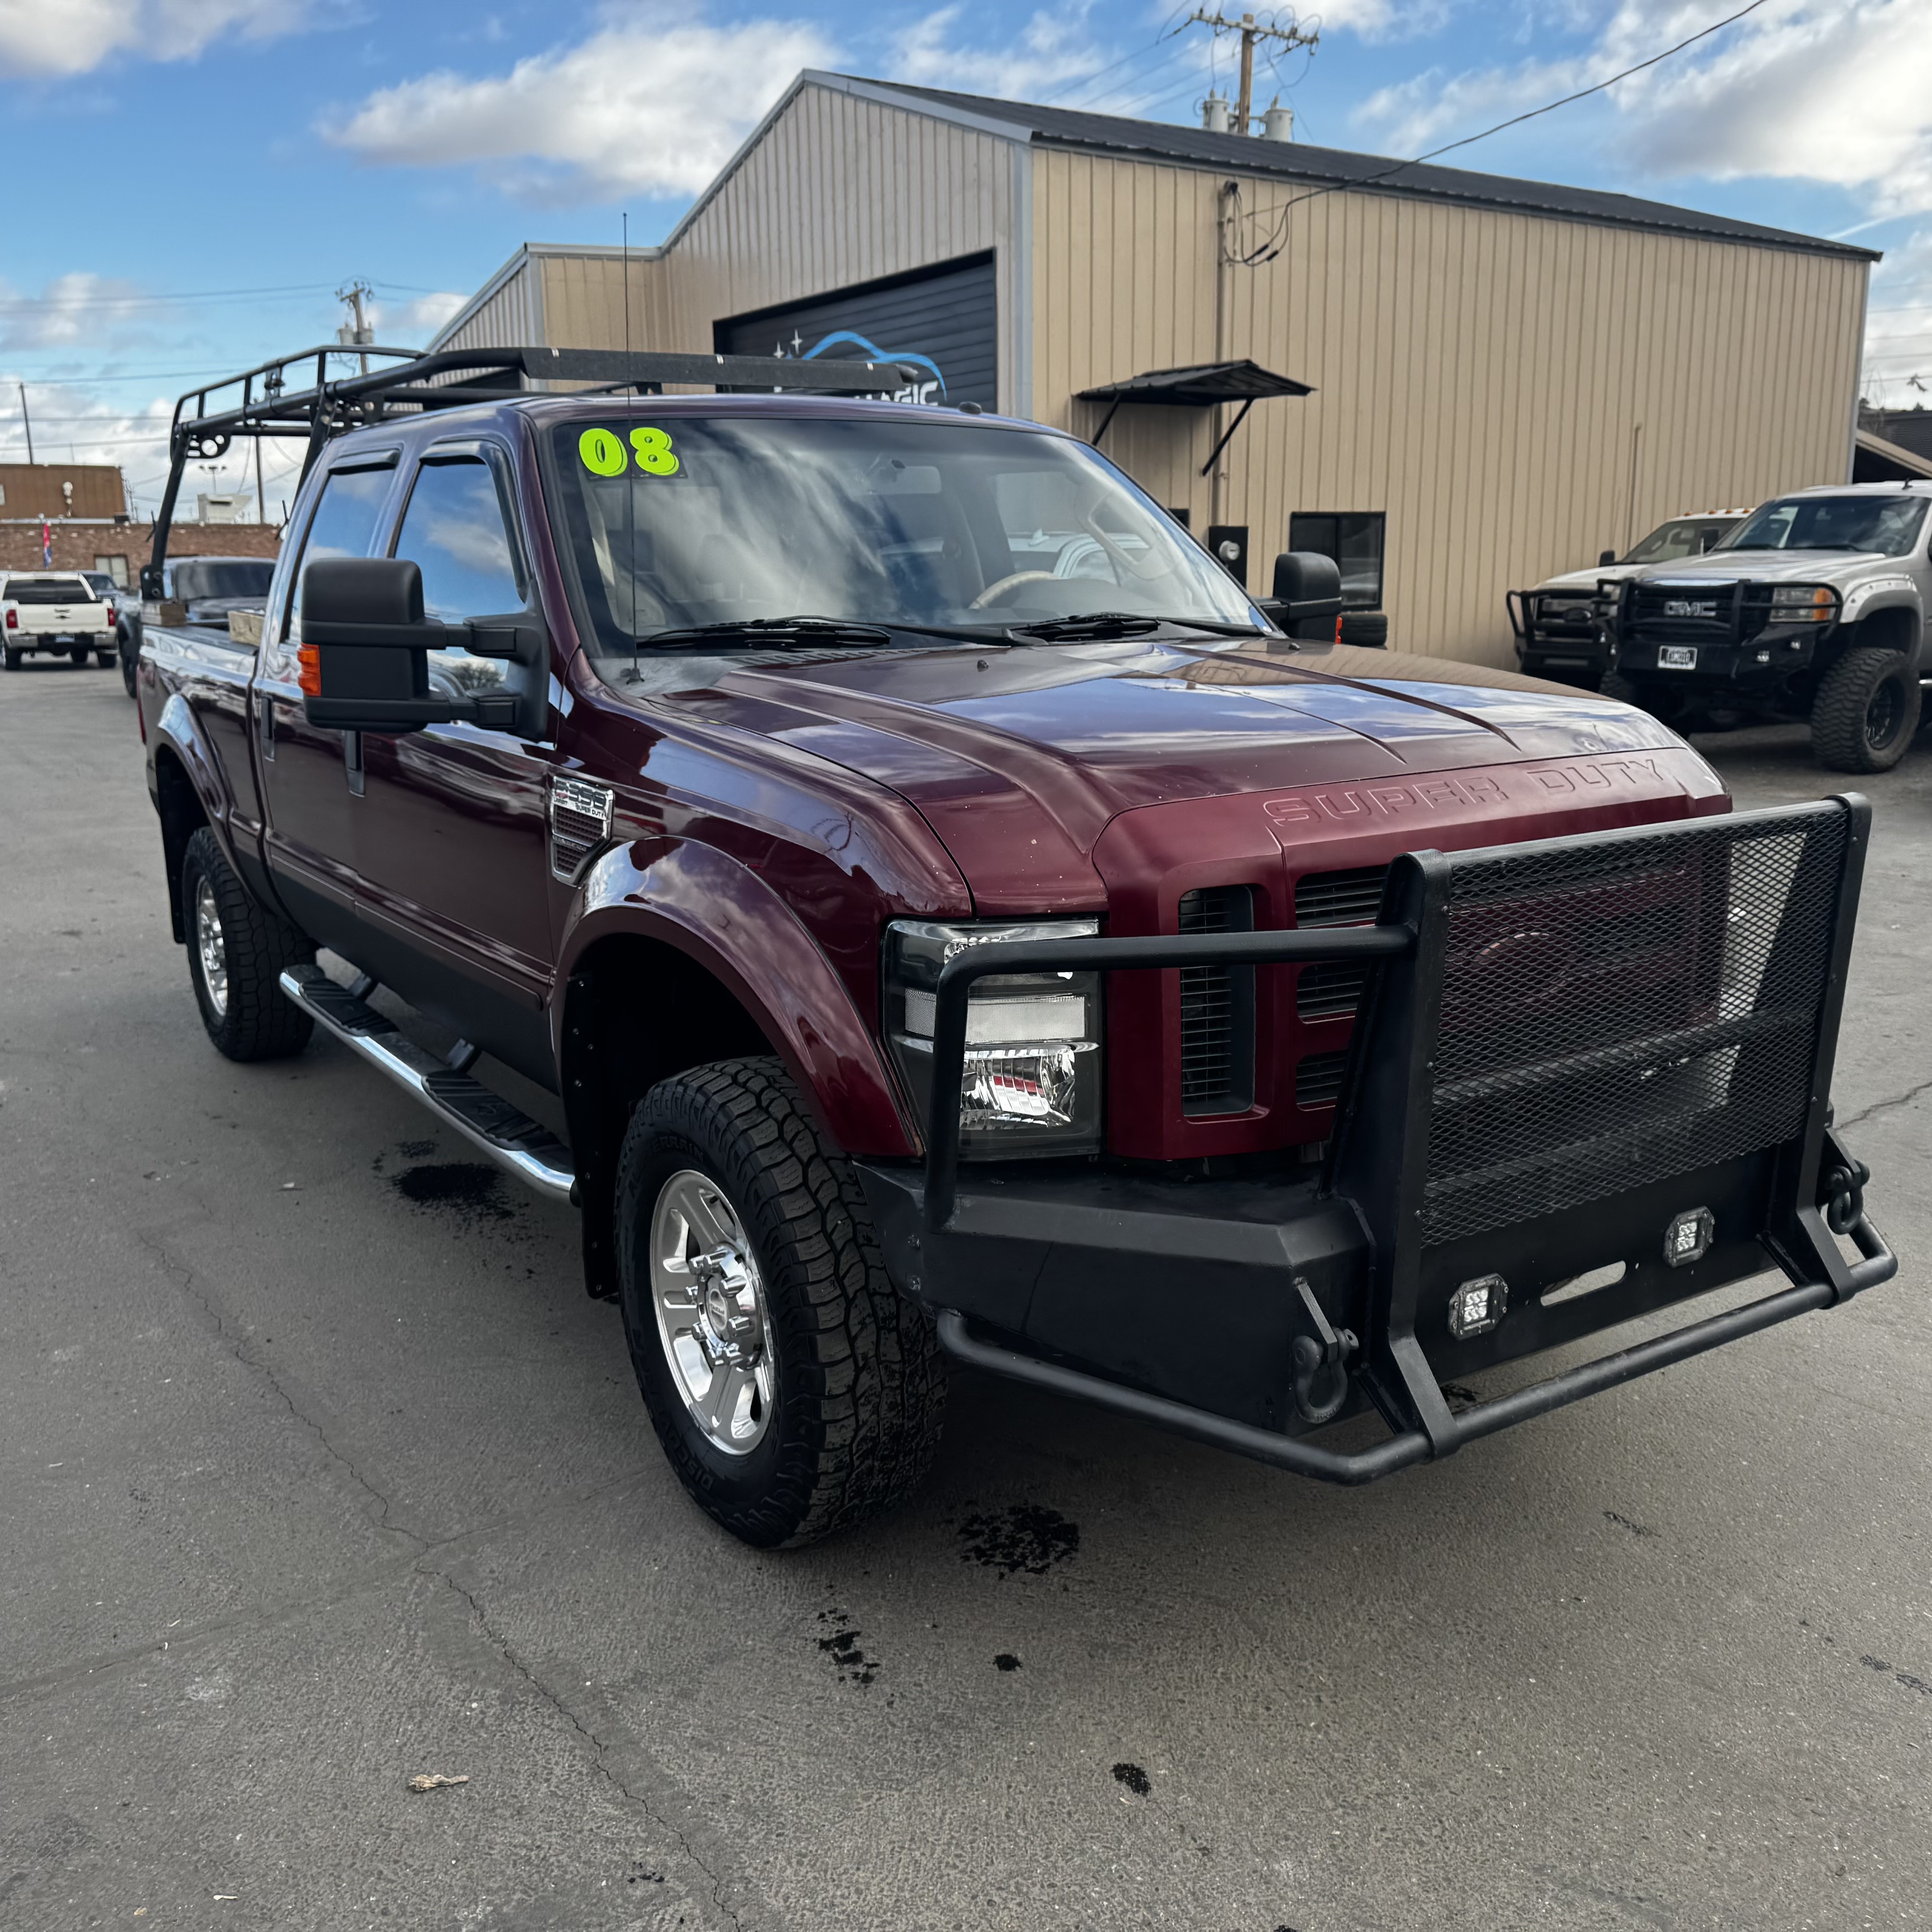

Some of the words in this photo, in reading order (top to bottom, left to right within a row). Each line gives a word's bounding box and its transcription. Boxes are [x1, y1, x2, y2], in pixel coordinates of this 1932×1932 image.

[854, 380, 938, 406] GIC
[579, 427, 679, 477] 08
[1663, 601, 1717, 617] GMC
[1262, 777, 1509, 827] SUPER
[1527, 759, 1664, 794] DUTY
